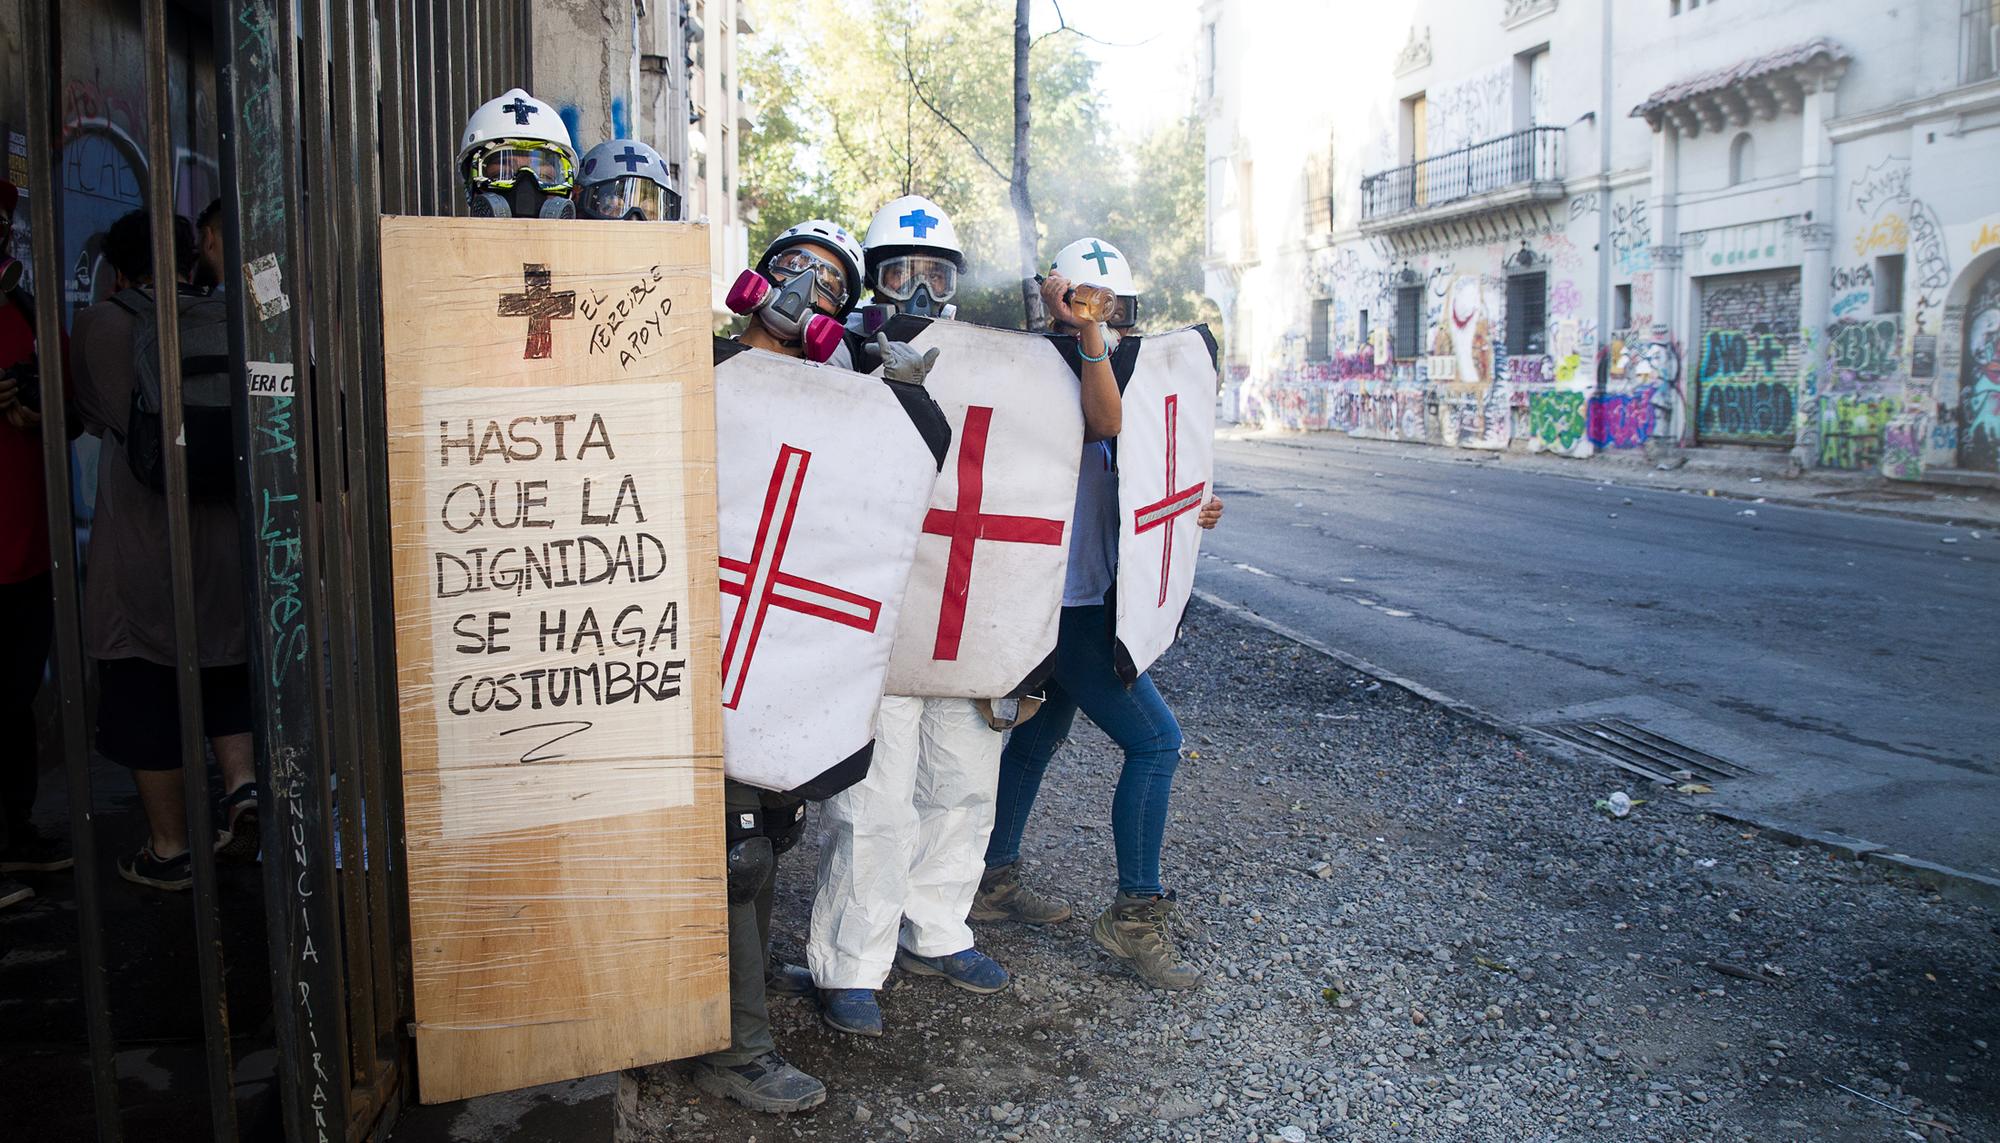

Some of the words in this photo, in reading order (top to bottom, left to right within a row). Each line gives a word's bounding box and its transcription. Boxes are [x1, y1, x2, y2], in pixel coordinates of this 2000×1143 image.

[580, 288, 608, 320] EL
[620, 298, 672, 372] APOYO
[248, 369, 276, 392] ERA
[440, 413, 616, 467] HASTA
[441, 479, 555, 533] QUE
[581, 474, 647, 526] LA
[435, 533, 667, 598] DIGNIDAD
[453, 611, 511, 655] SE
[539, 601, 678, 657] HAGA
[448, 658, 686, 715] COSTUMBRE
